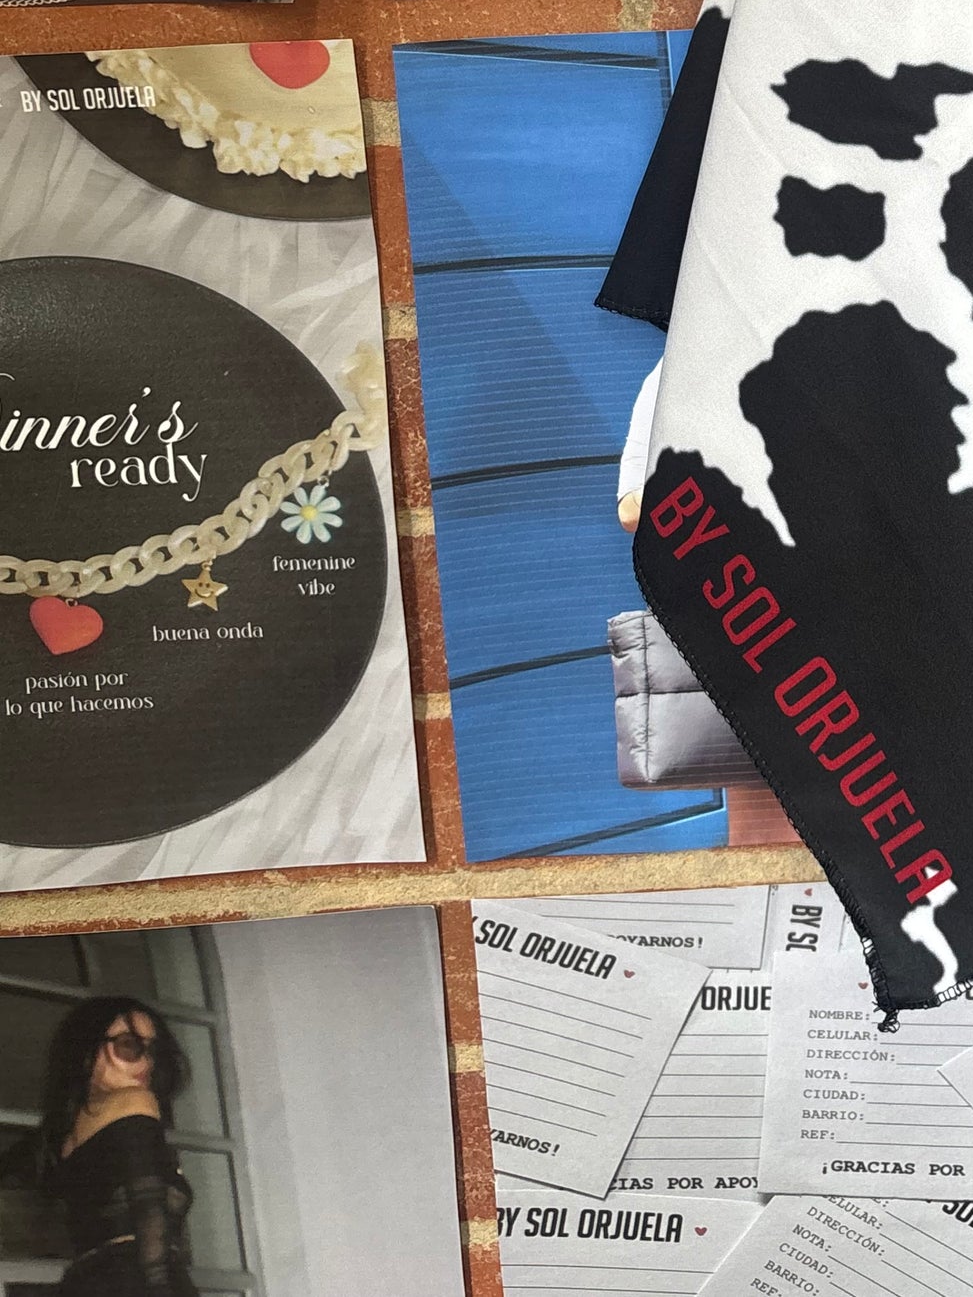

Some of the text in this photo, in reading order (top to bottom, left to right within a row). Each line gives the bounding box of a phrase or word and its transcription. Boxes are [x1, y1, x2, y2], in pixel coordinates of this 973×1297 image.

[20, 85, 157, 112] BY SOL ORJUELA
[70, 442, 208, 502] ready
[272, 554, 356, 572] femenine
[298, 579, 336, 596] vibe
[152, 621, 264, 642] buena onda
[25, 671, 129, 694] pasión por
[650, 476, 955, 904] BY SOL ORJUELA
[6, 694, 154, 720] lo que hacemos
[790, 904, 823, 929] BY
[475, 919, 617, 980] SOL ORJUELA
[809, 1009, 870, 1021] NOMBRE:
[807, 1029, 878, 1041] CELULAR:
[806, 1048, 895, 1062] DIRECCIÓN:
[805, 1069, 848, 1081] NOTA:
[803, 1089, 866, 1101] CIUDAD:
[802, 1109, 865, 1121] BARRIO:
[800, 1129, 836, 1140] REF:
[821, 1159, 966, 1177] ¡GRACIAS POR
[667, 1177, 704, 1190] POR
[524, 1206, 570, 1238] SOL
[577, 1208, 683, 1243] ORJUELA
[806, 1206, 885, 1257] DIRECCIÓN:
[792, 1224, 832, 1252] NOTA:
[779, 1242, 834, 1279] CIUDAD:
[764, 1259, 820, 1297] BARRIO:
